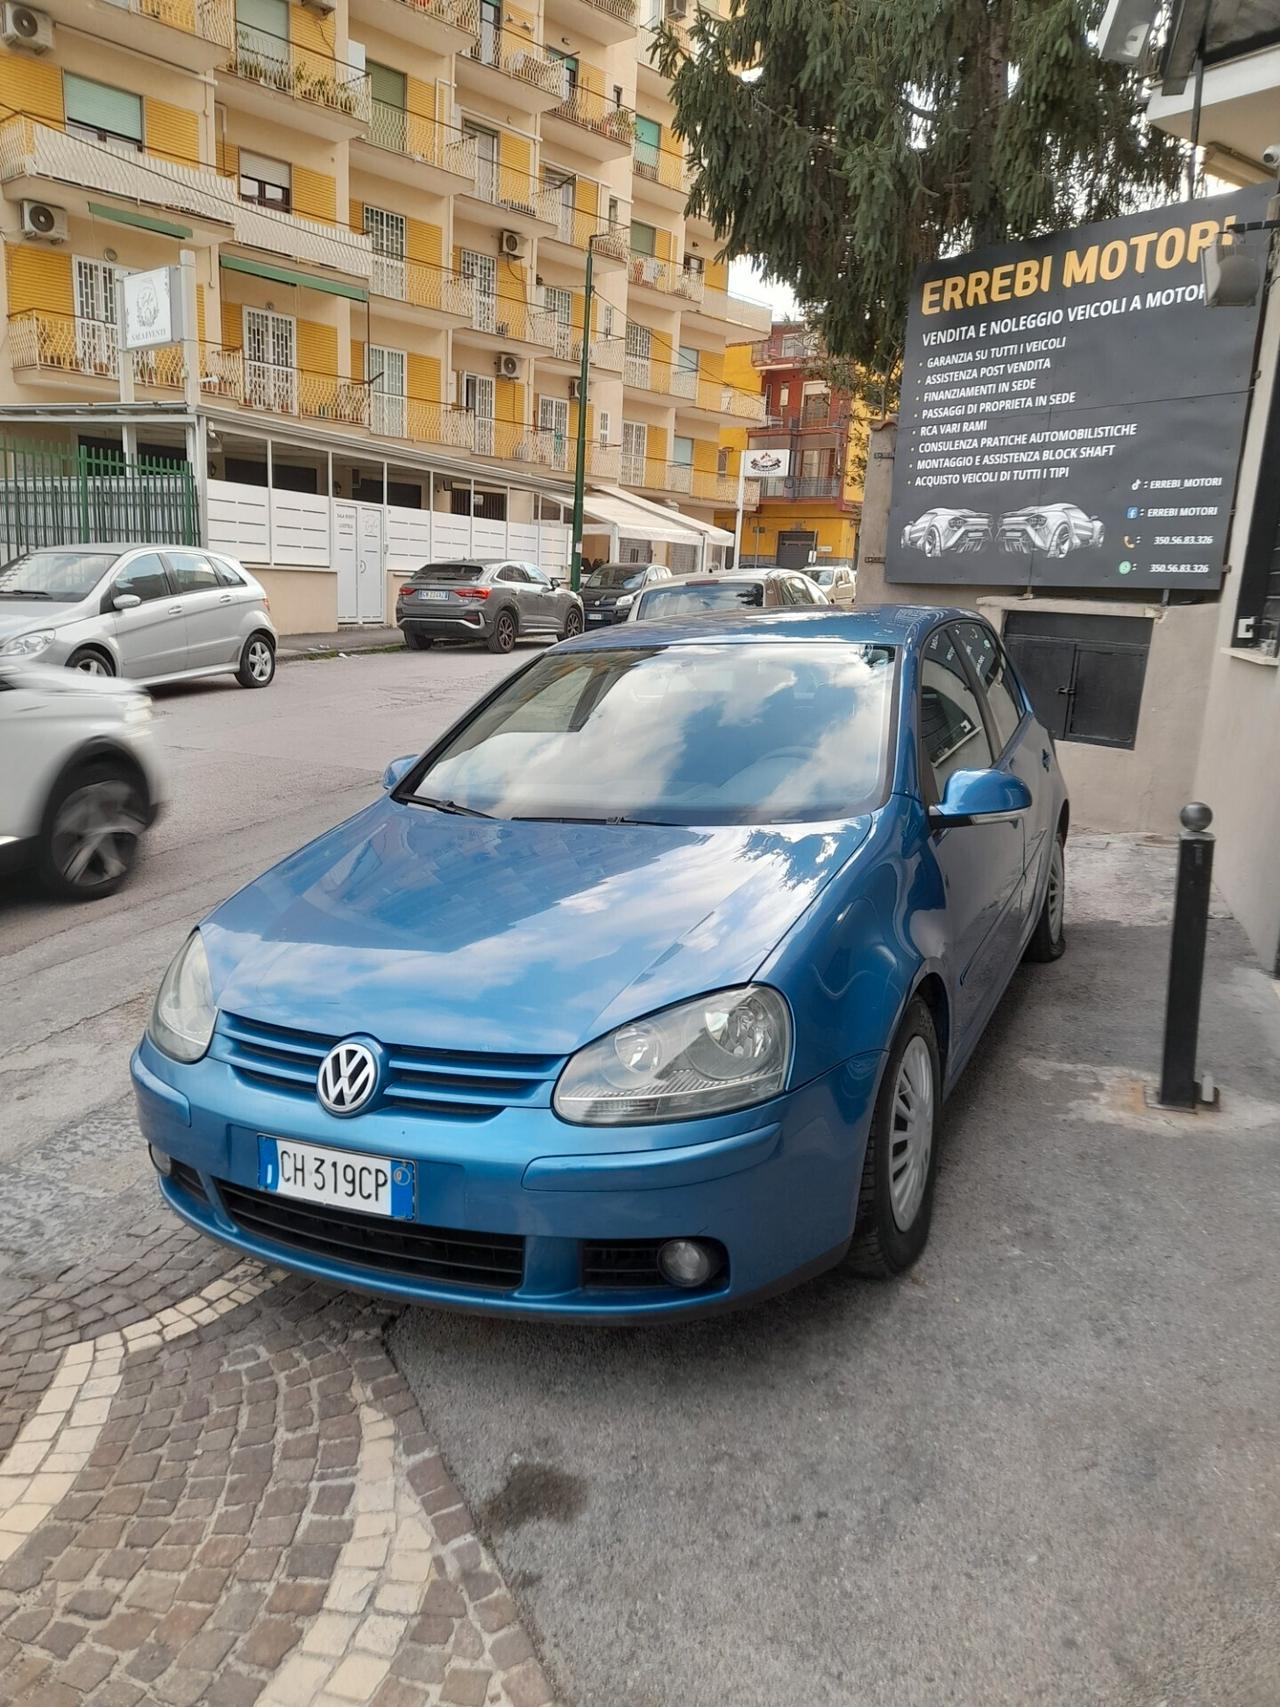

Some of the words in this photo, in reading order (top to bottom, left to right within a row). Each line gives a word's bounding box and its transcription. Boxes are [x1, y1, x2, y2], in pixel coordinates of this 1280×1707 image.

[920, 255, 1052, 316] ERREBI
[922, 323, 976, 347] VENDITA
[979, 322, 988, 338] E
[990, 308, 1064, 335] NOLEGGIO
[1067, 297, 1127, 322] VEICOLI
[1130, 295, 1142, 311] A
[927, 352, 973, 368] GARANZIA
[975, 349, 988, 361] SU
[991, 344, 1018, 359] TUTTI
[1026, 337, 1066, 353] VEICOLI
[925, 368, 978, 386] ASSISTENZA
[980, 364, 1006, 377] POST
[1007, 358, 1051, 374] VENDITA
[924, 384, 996, 402] FINANZIAMENTI
[998, 382, 1010, 393] IN
[1011, 378, 1037, 391] SEDE
[922, 406, 965, 420] PASSAGGI
[967, 404, 977, 415] DI
[979, 398, 1033, 414] PROPRIETA
[1035, 396, 1047, 406] IN
[1049, 391, 1077, 405] SEDE
[918, 438, 979, 454] CONSULENZA
[980, 433, 1028, 448] PRATICHE
[1029, 423, 1138, 445] AUTOMOBILISTICHE
[920, 425, 938, 437] RCA
[939, 422, 961, 434] VARI
[962, 420, 988, 432] RAMI
[917, 456, 973, 470] MONTAGGIO
[975, 454, 982, 465] E
[982, 449, 1040, 465] ASSISTENZA
[1042, 447, 1078, 461] BLOCK
[1079, 444, 1116, 458] SHAFT
[915, 473, 959, 488] ACQUISTO
[962, 471, 998, 483] VEICOLI
[1000, 470, 1011, 481] DI
[1013, 468, 1041, 481] TUTTI
[1049, 466, 1069, 478] TIPI
[1147, 508, 1178, 517] ERREBI
[1179, 507, 1218, 516] MOTORI
[280, 1150, 305, 1187] CH
[314, 1157, 388, 1202] 319CP
